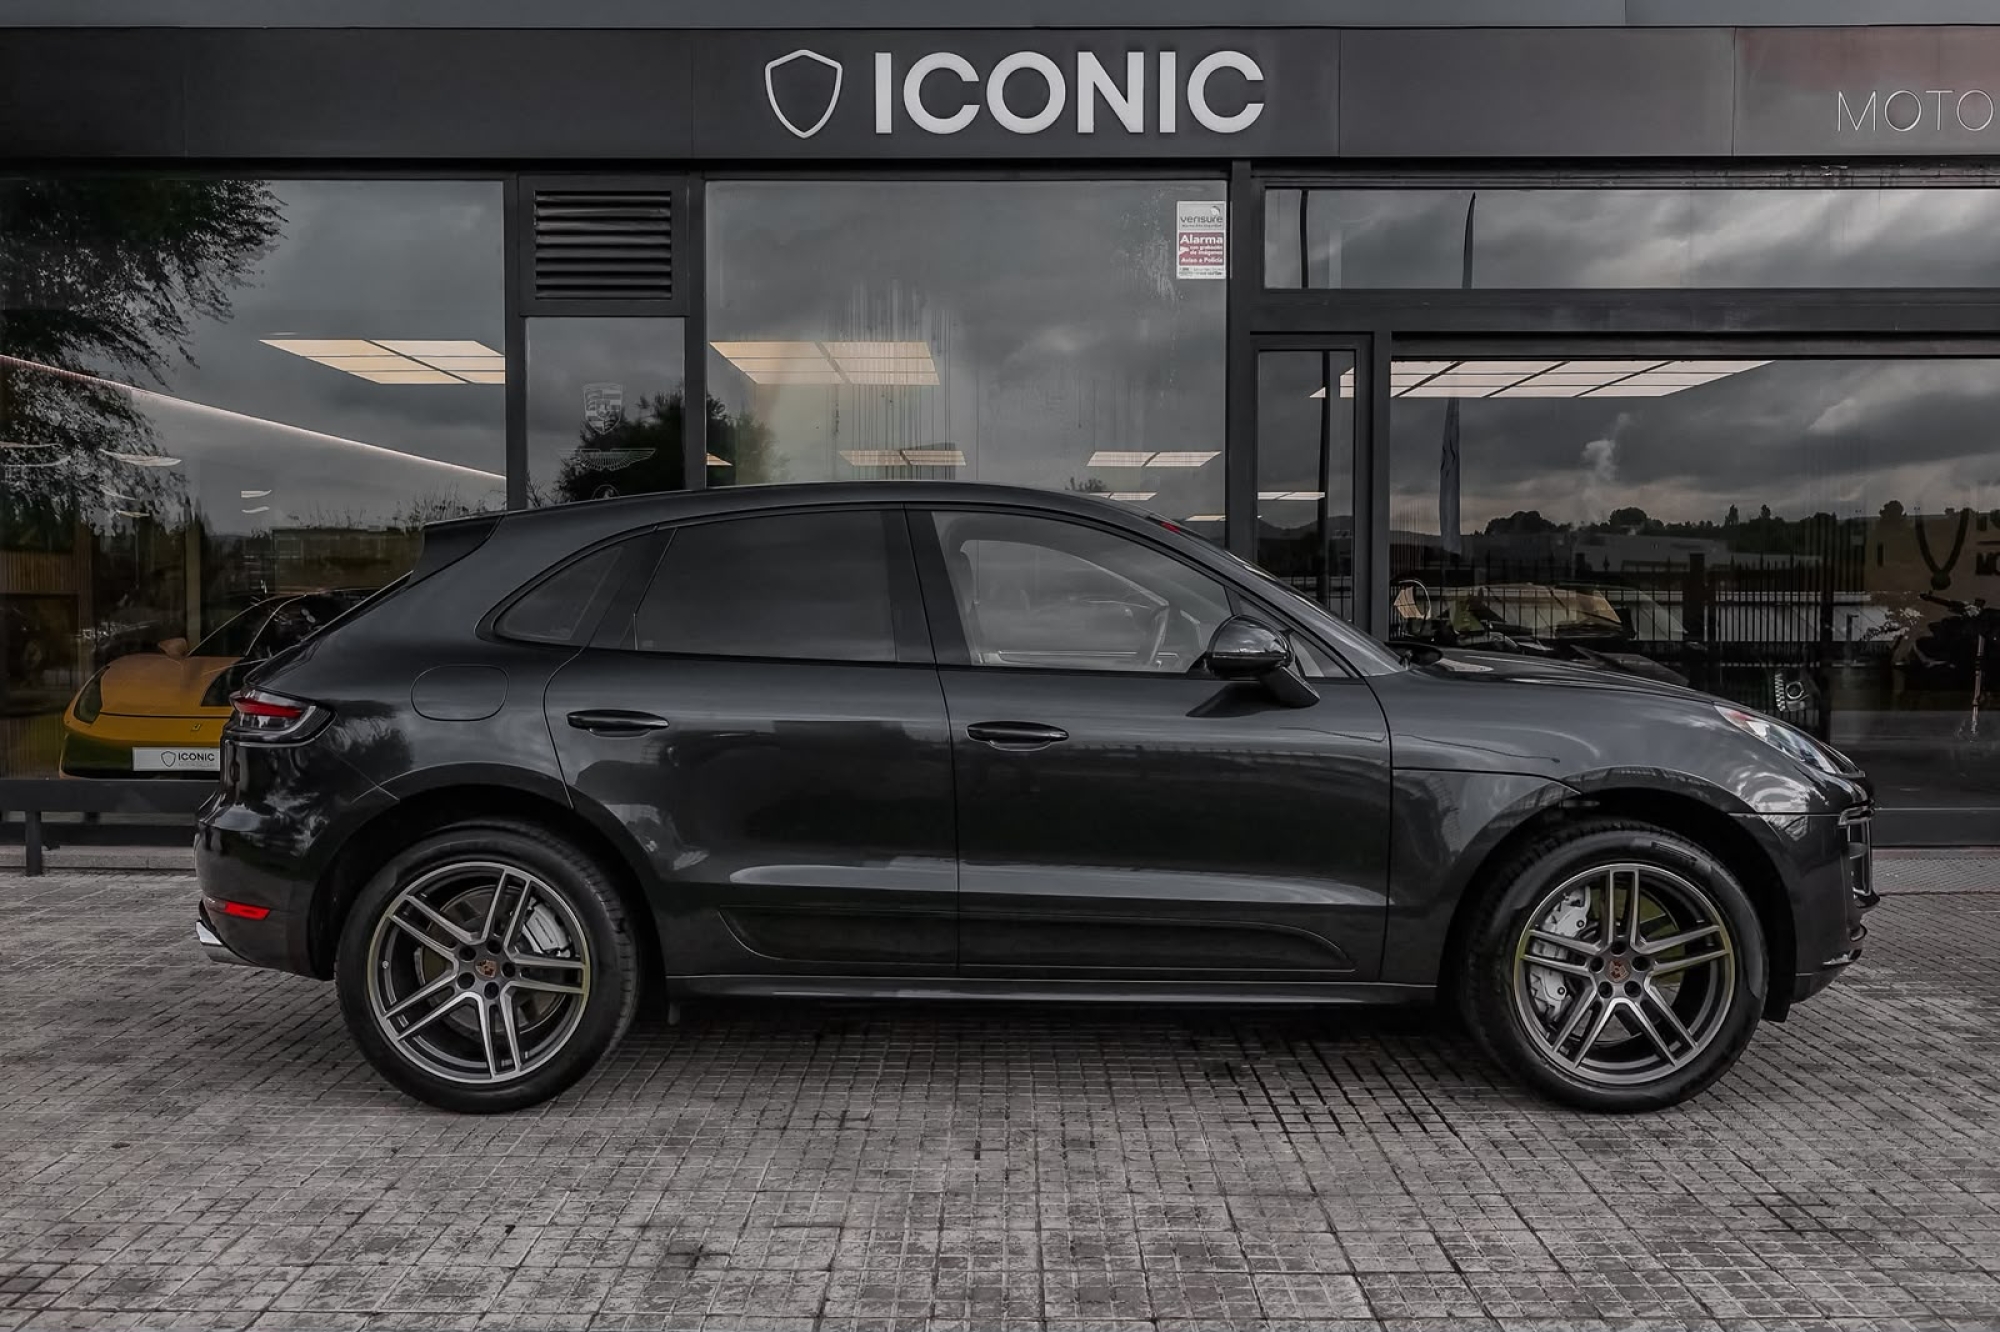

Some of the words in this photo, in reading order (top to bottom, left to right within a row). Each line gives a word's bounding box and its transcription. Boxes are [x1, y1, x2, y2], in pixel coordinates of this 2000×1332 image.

[875, 50, 1264, 134] ICONIC
[1838, 89, 1995, 131] MOTO
[1180, 215, 1223, 224] verisure
[1180, 234, 1223, 244] Alarma
[178, 752, 215, 761] ICONIC
